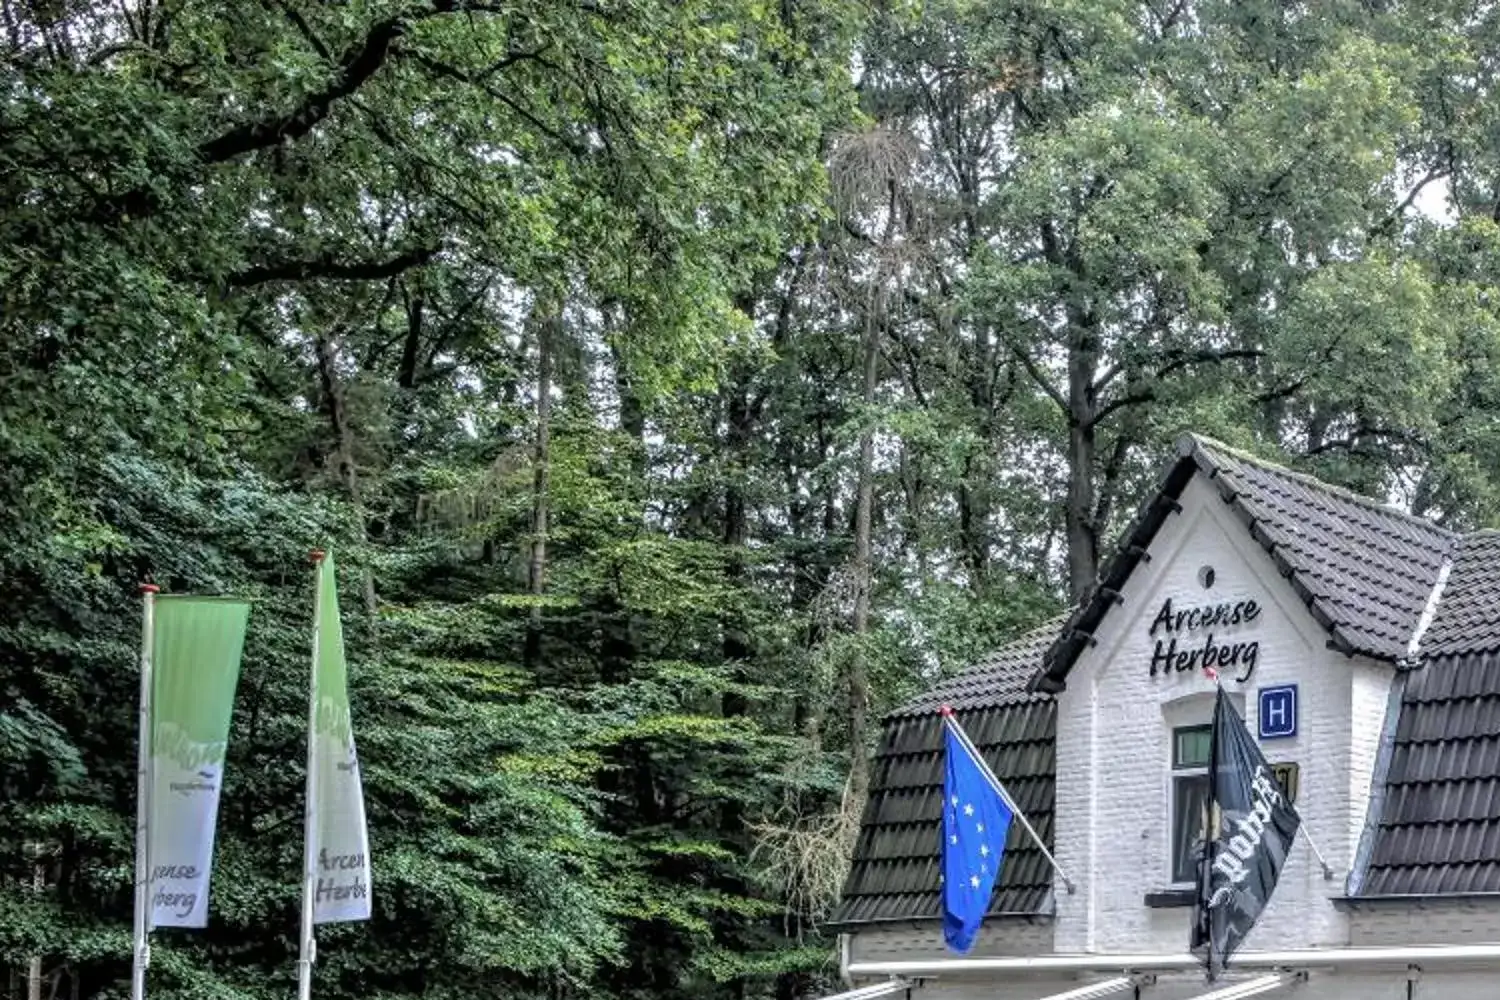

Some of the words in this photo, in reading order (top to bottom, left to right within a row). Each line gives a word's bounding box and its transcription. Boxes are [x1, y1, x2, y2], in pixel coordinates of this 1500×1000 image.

[1148, 597, 1262, 636] Arcense
[1150, 633, 1260, 683] Herberg
[1268, 697, 1286, 728] H
